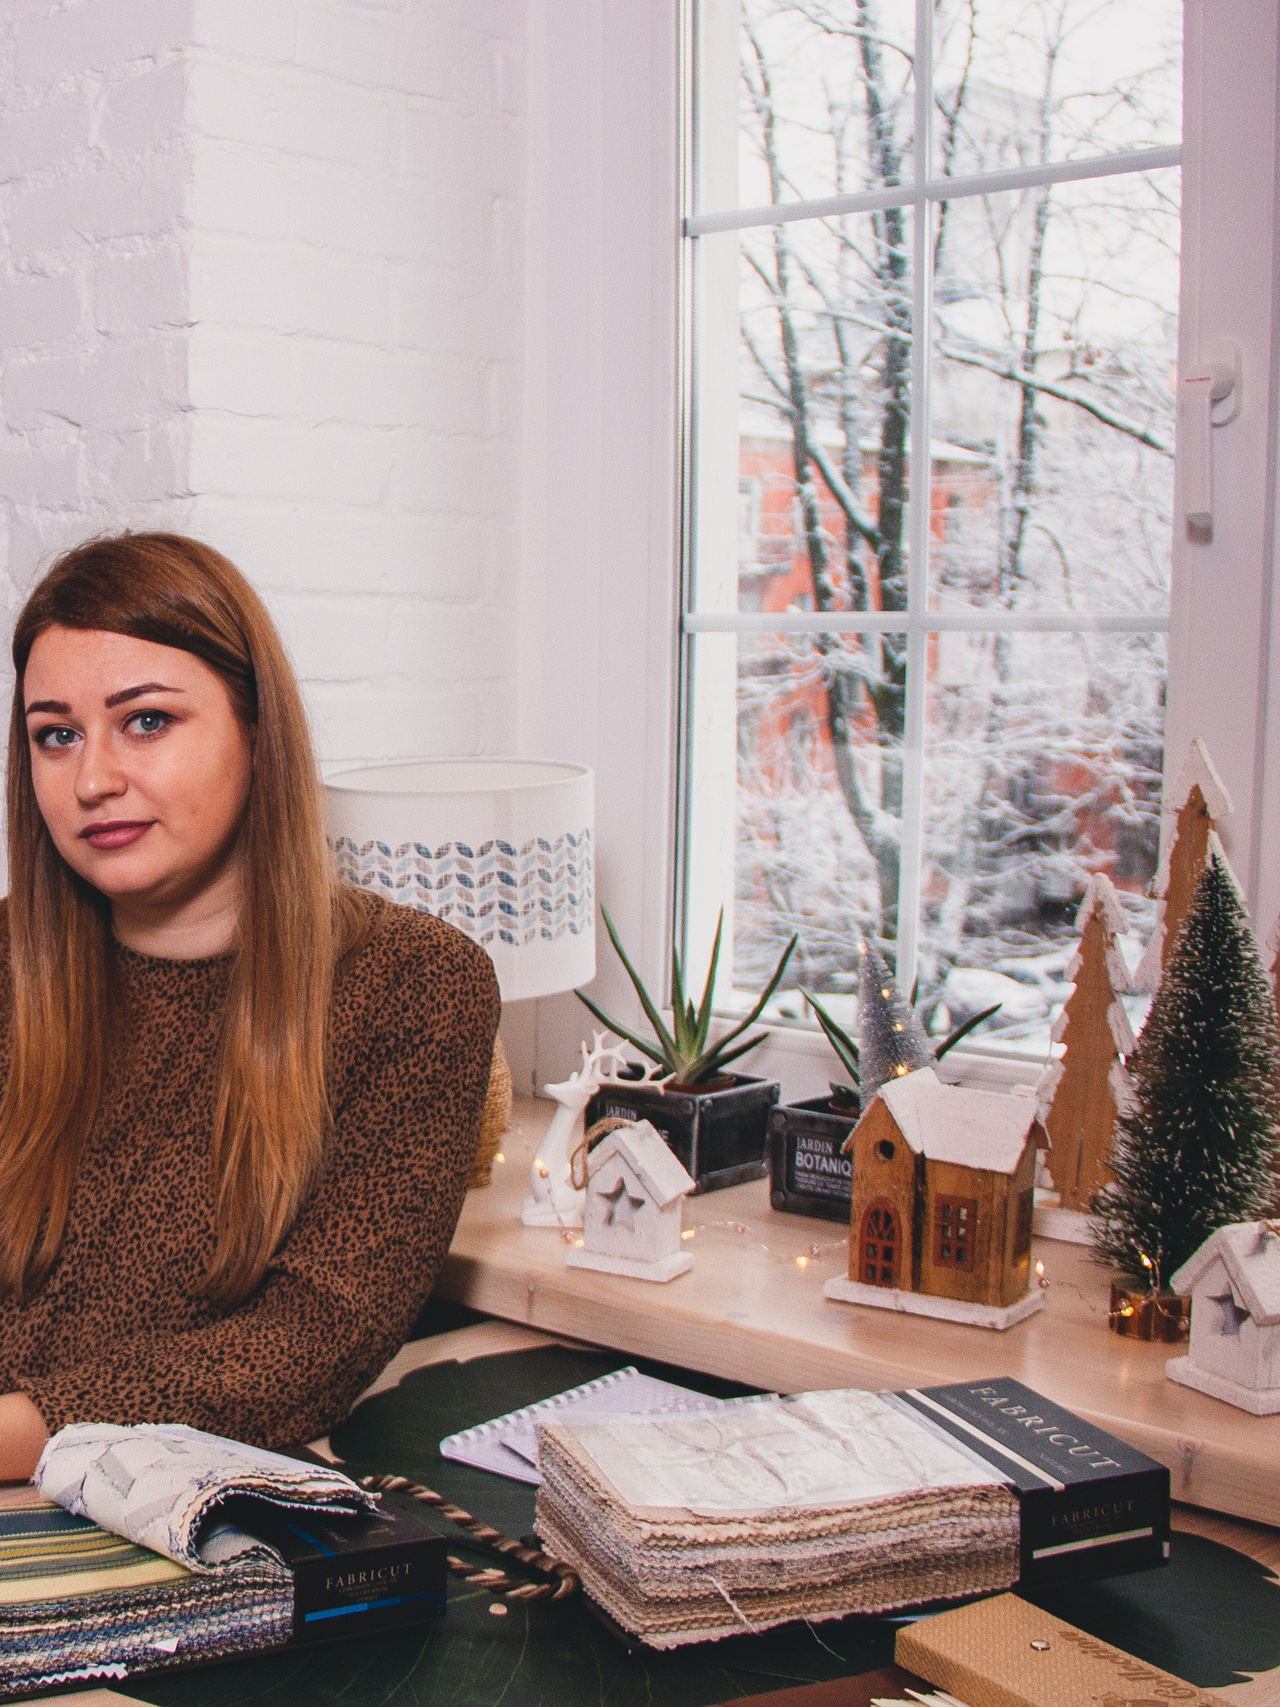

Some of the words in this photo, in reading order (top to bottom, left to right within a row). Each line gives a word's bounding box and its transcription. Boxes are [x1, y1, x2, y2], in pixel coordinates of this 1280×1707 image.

[605, 1104, 637, 1121] JARDIN
[796, 1136, 833, 1155] JARDIN
[795, 1151, 852, 1177] BOTANIQ
[970, 1386, 1121, 1468] FABRICUT
[1051, 1499, 1135, 1526] FABRICUT
[326, 1562, 412, 1589] FABRICUT
